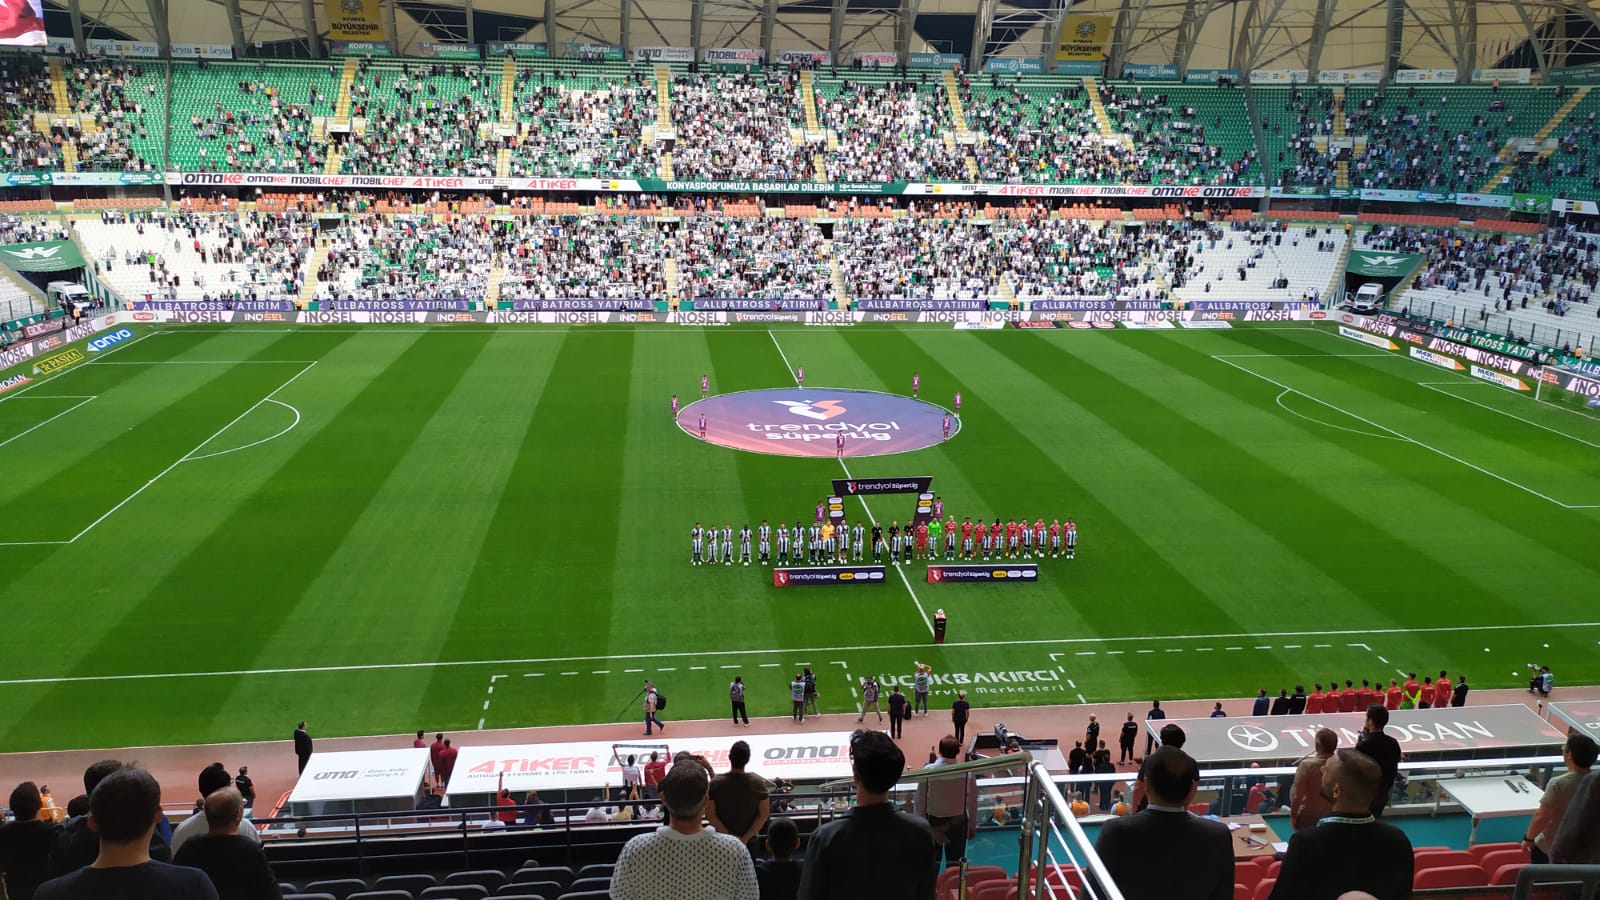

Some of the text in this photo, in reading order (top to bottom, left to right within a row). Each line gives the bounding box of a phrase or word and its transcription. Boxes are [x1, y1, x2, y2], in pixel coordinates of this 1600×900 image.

[523, 301, 593, 309] ALBATROSS
[937, 301, 980, 309] YATIRIM
[1446, 329, 1549, 362] ALLBTROSS YATIRM
[745, 421, 901, 433] trendyol
[858, 482, 892, 491] trendyol
[975, 684, 1065, 695] Merkezleri
[313, 770, 359, 781] oma
